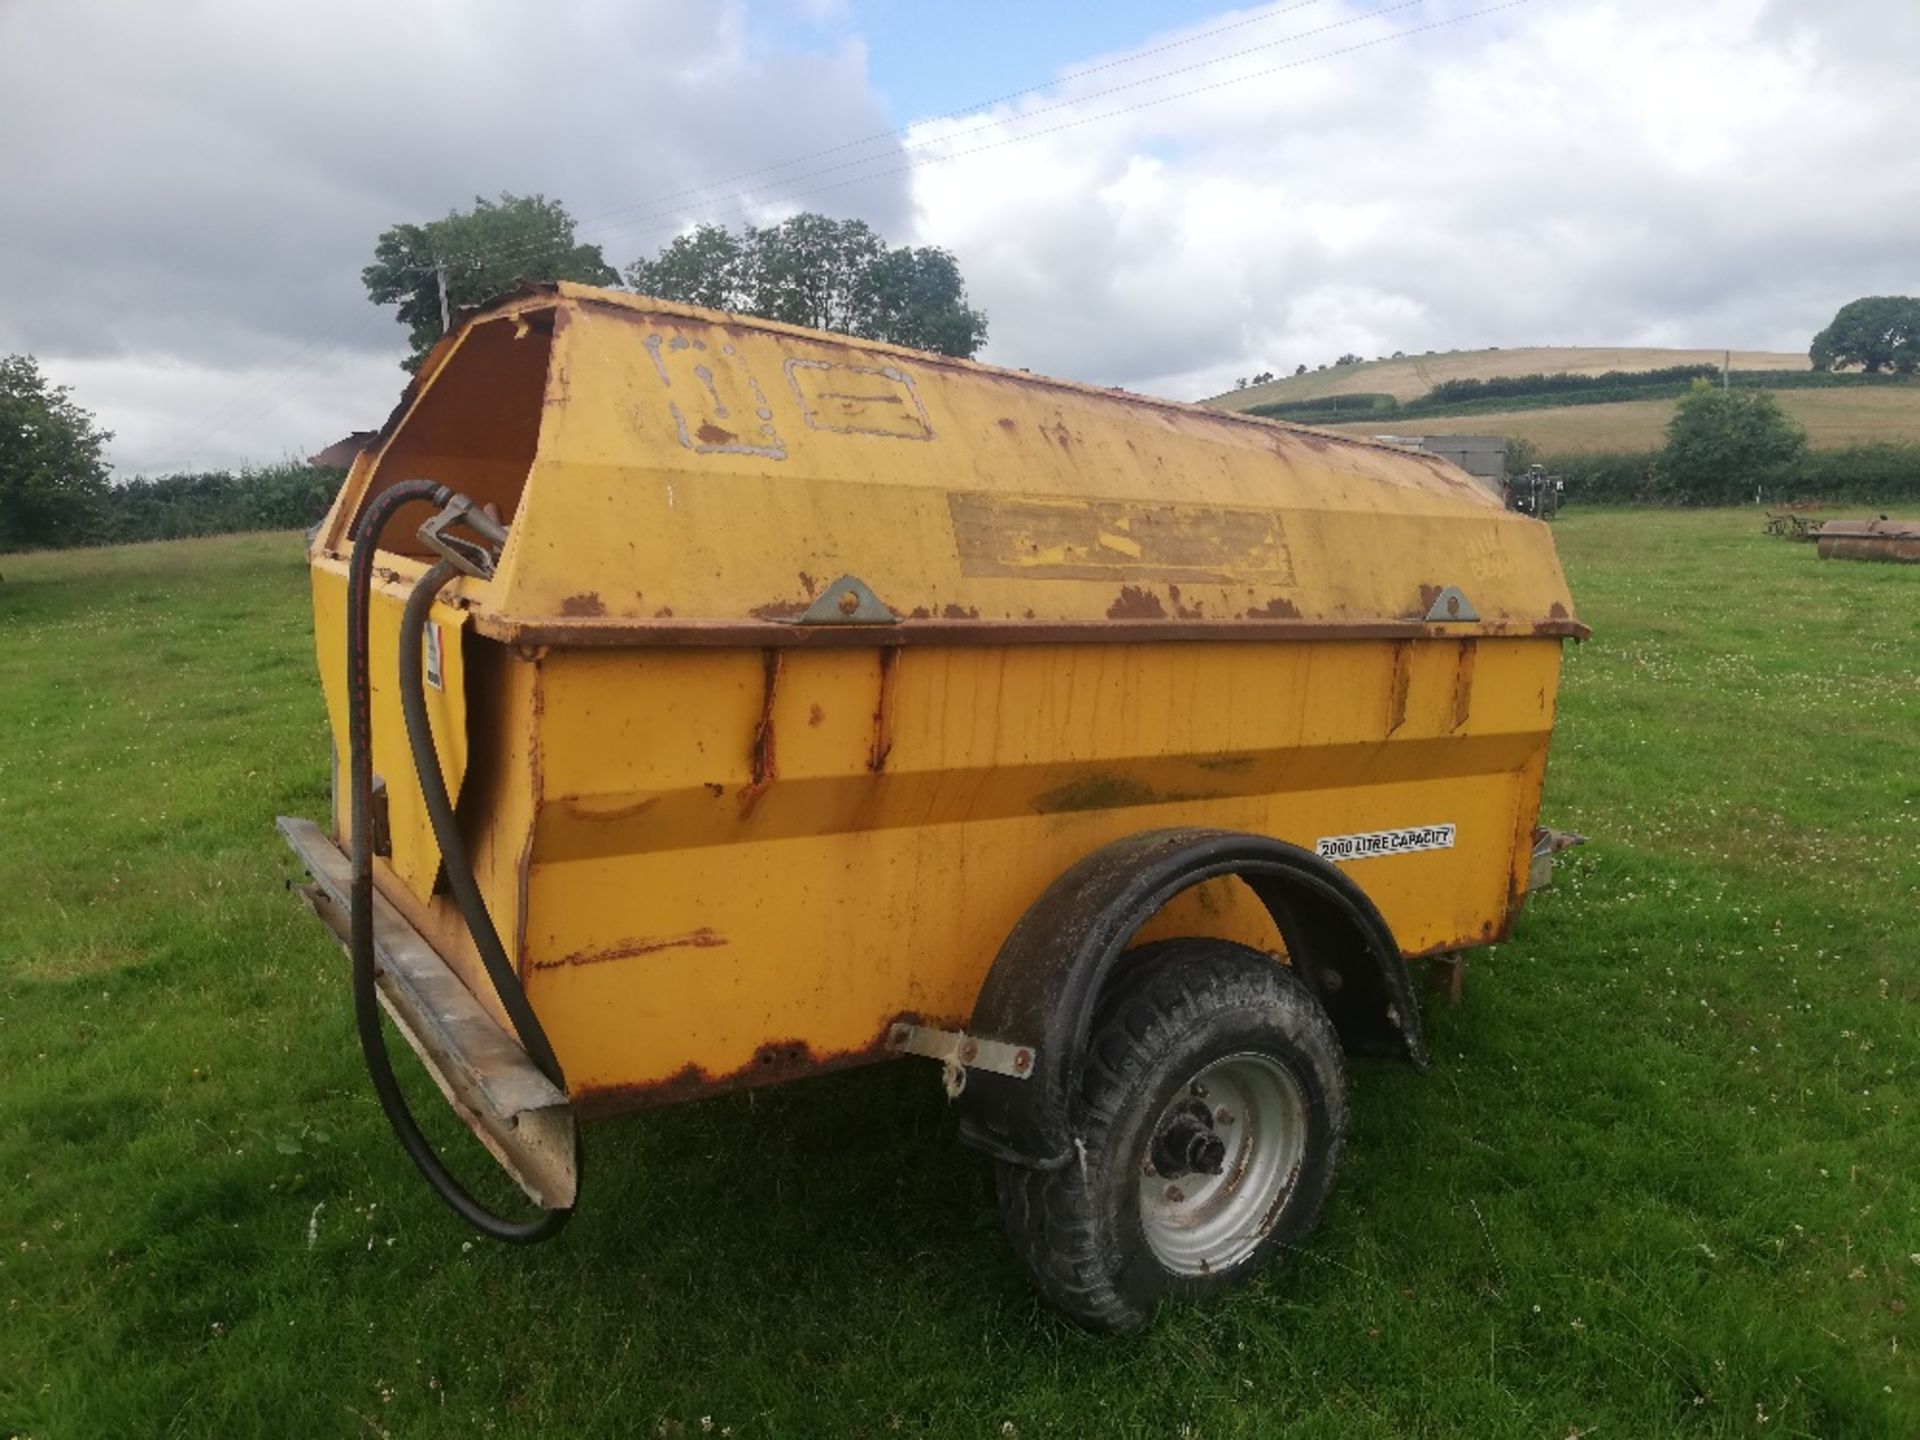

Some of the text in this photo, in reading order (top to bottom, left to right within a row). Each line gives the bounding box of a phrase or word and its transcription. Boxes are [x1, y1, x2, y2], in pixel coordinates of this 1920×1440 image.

[1322, 831, 1449, 855] 2000 LITRE CAPACITY
